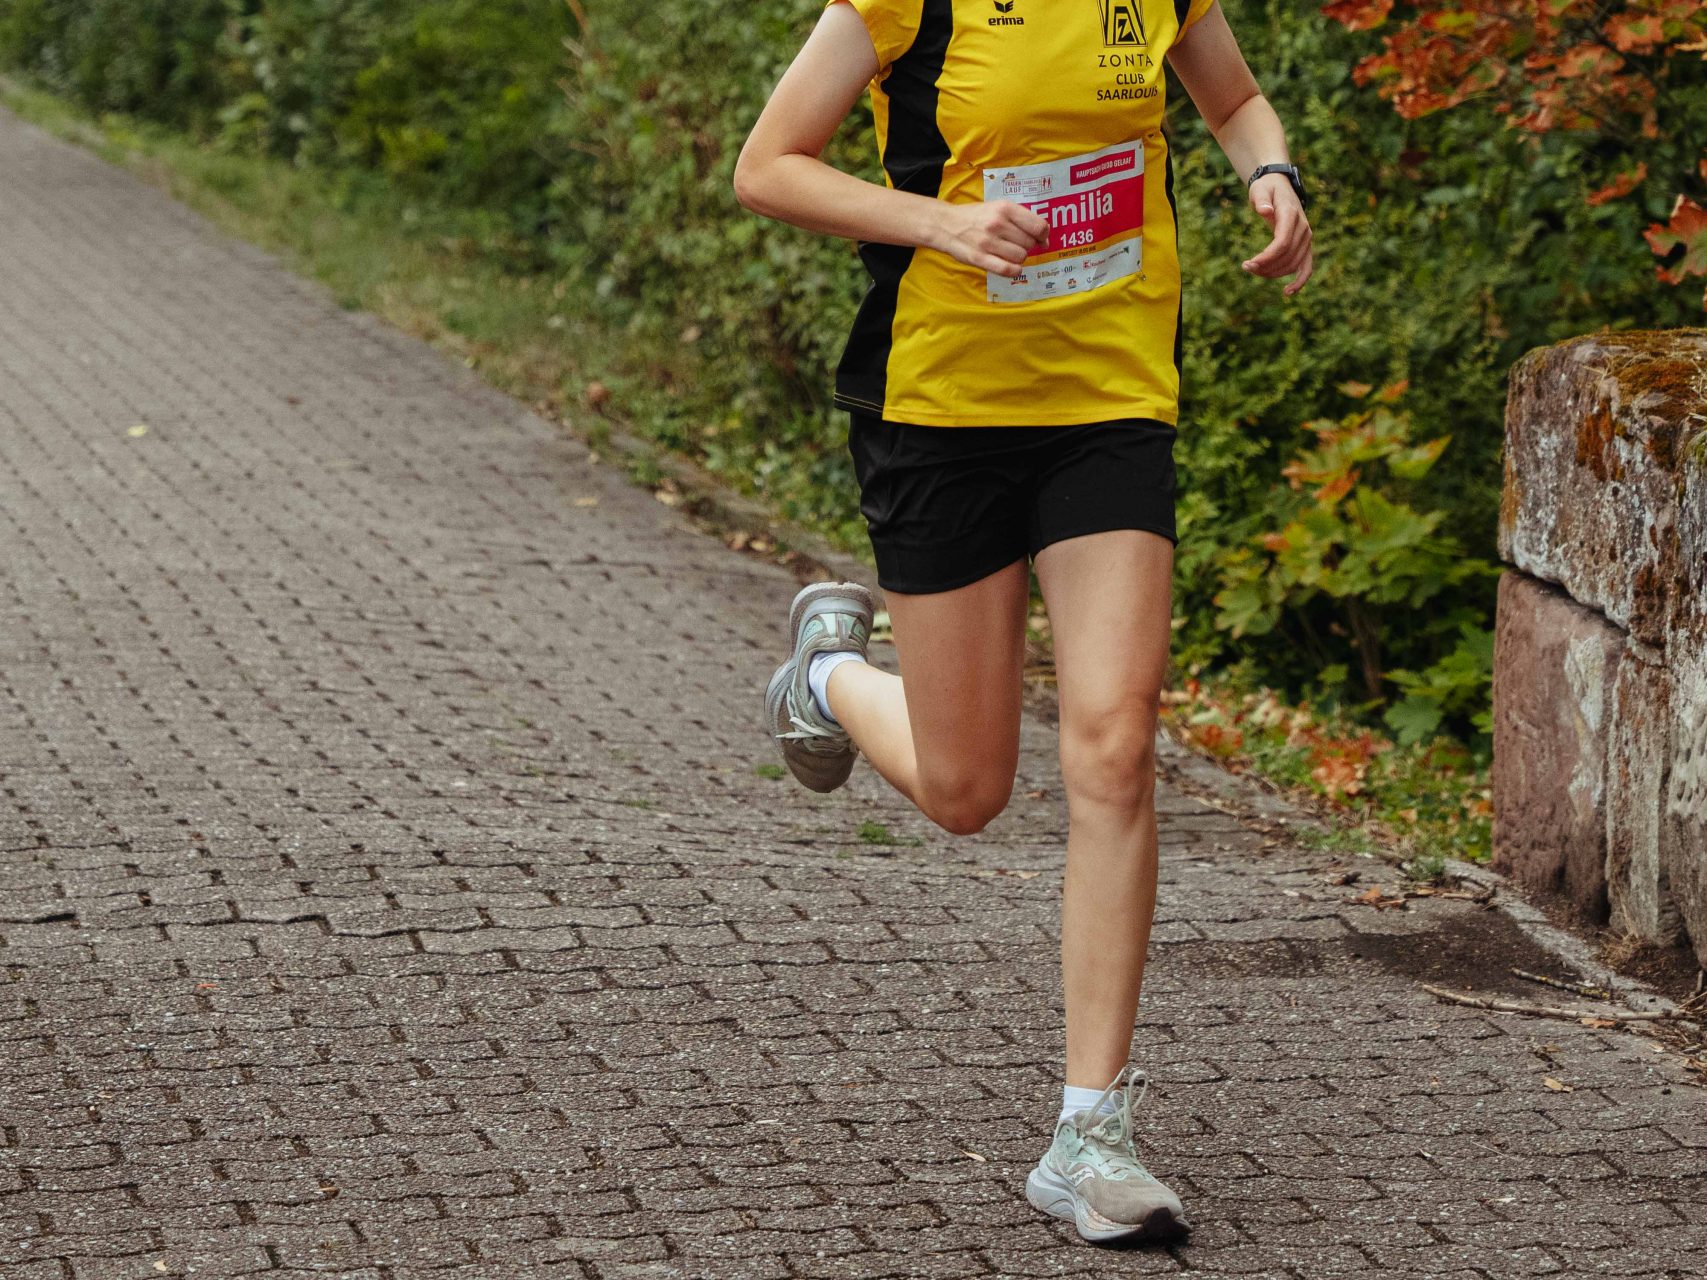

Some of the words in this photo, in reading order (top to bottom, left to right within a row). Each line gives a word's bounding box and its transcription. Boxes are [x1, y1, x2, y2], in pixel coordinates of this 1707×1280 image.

[988, 15, 1024, 26] erima
[1097, 54, 1154, 68] ZONTA
[1116, 73, 1145, 85] CLUB
[1096, 85, 1158, 101] SAARLOUIS
[1113, 156, 1132, 167] GELAAF
[1031, 191, 1114, 228] Emilia
[1060, 228, 1094, 248] 1436
